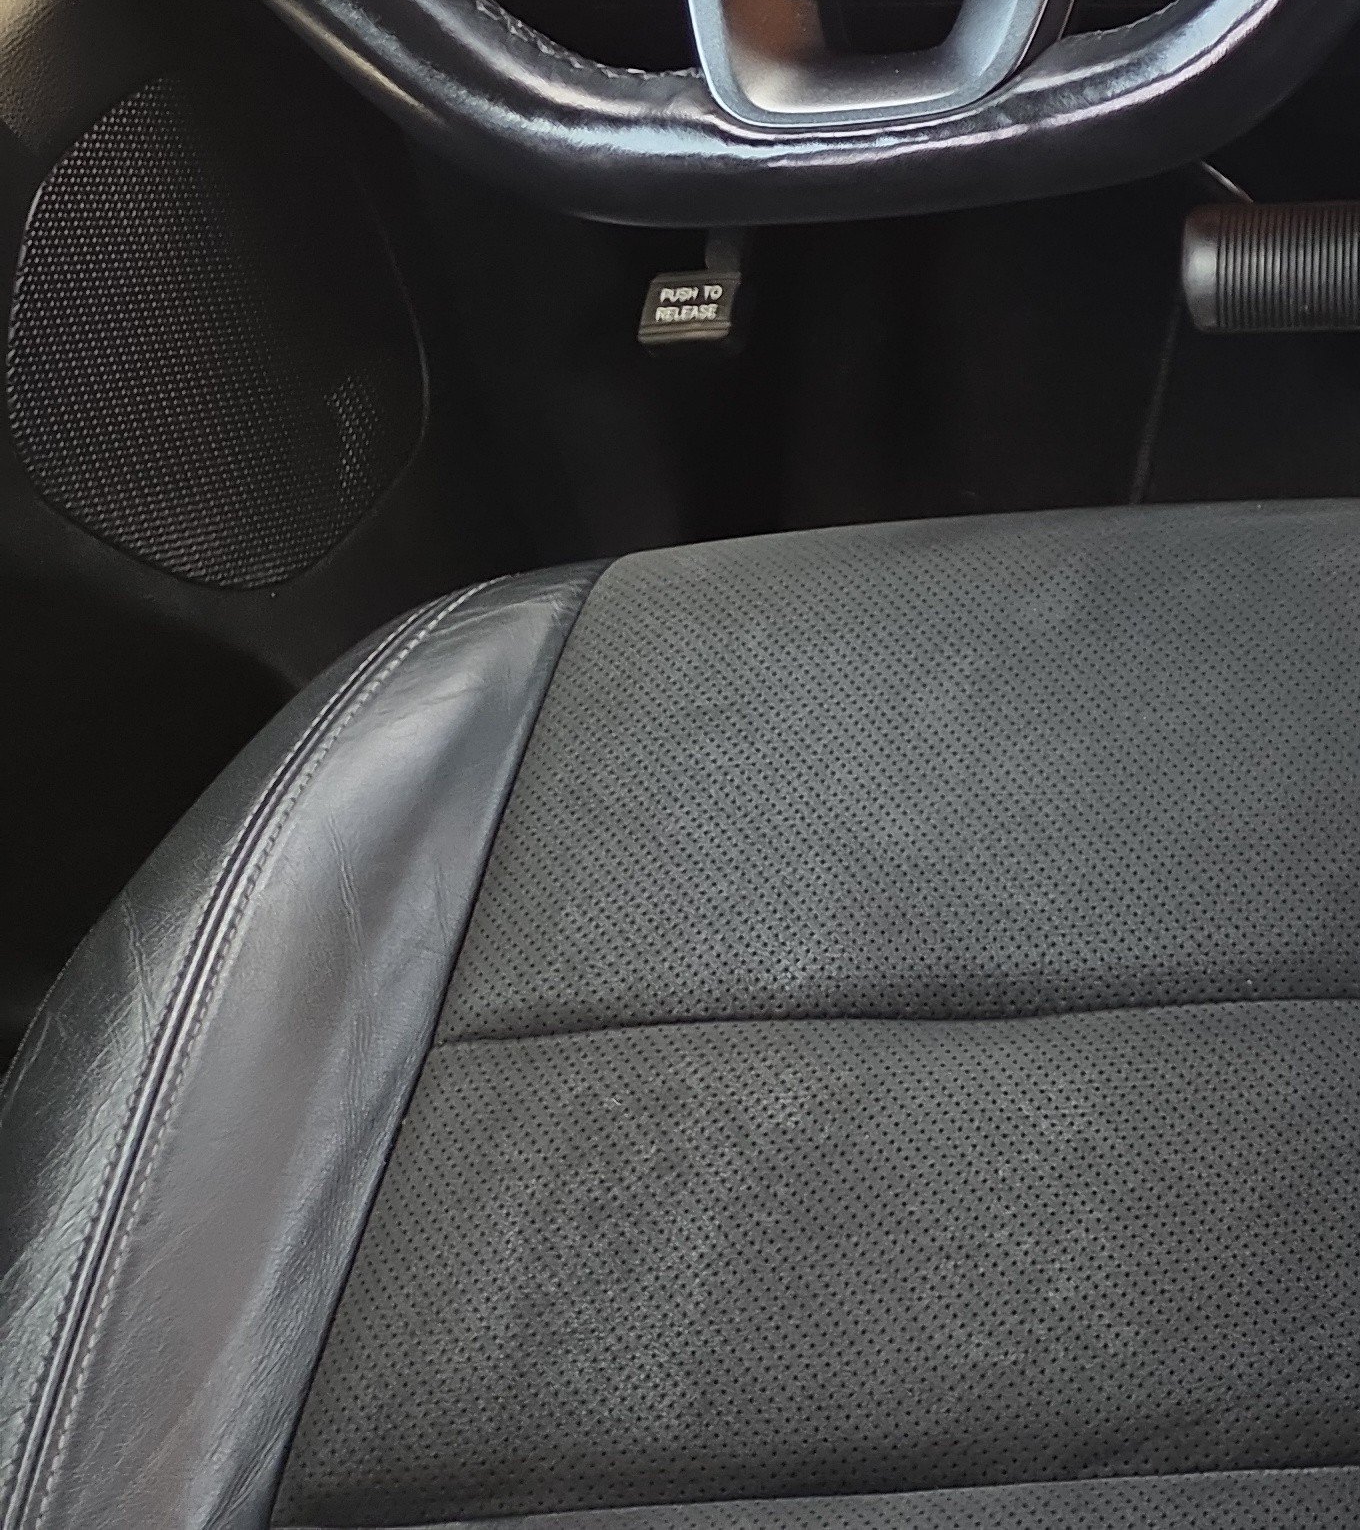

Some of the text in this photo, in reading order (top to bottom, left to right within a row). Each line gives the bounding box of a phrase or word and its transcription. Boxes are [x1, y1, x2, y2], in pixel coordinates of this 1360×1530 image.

[660, 284, 723, 304] PUSH TO
[655, 303, 718, 323] RELEASE
